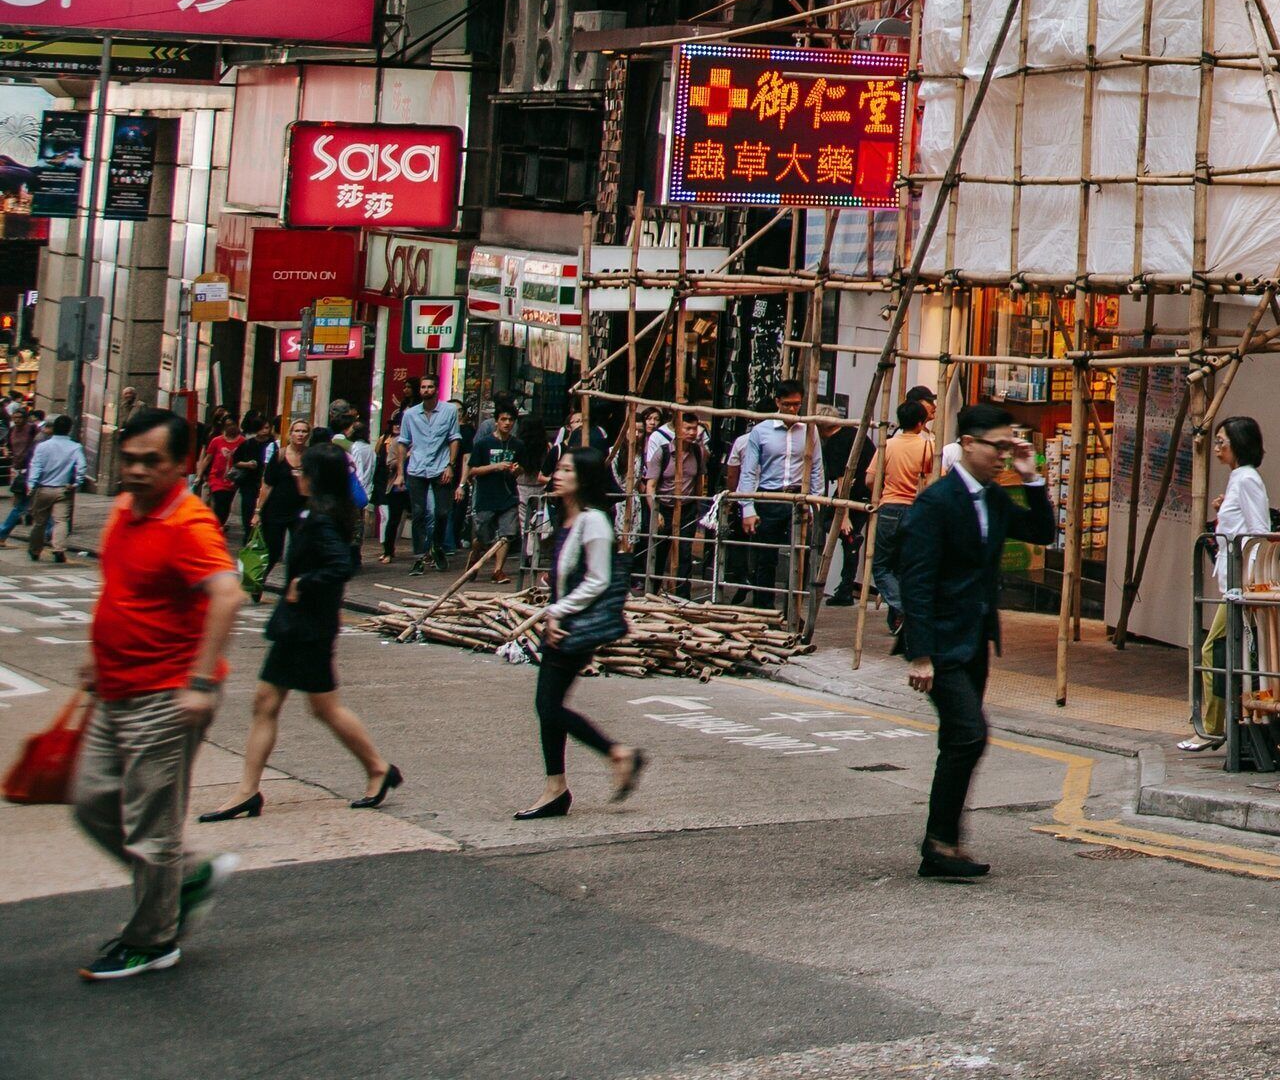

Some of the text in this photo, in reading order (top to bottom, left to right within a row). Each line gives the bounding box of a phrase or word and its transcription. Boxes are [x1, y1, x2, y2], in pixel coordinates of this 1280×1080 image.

[750, 71, 900, 134] 御仁堂
[310, 134, 440, 183] Sasa
[337, 184, 394, 219] 莎莎
[273, 271, 337, 281] COTTON ON
[416, 325, 453, 336] ELEVEn
[419, 304, 454, 351] 7
